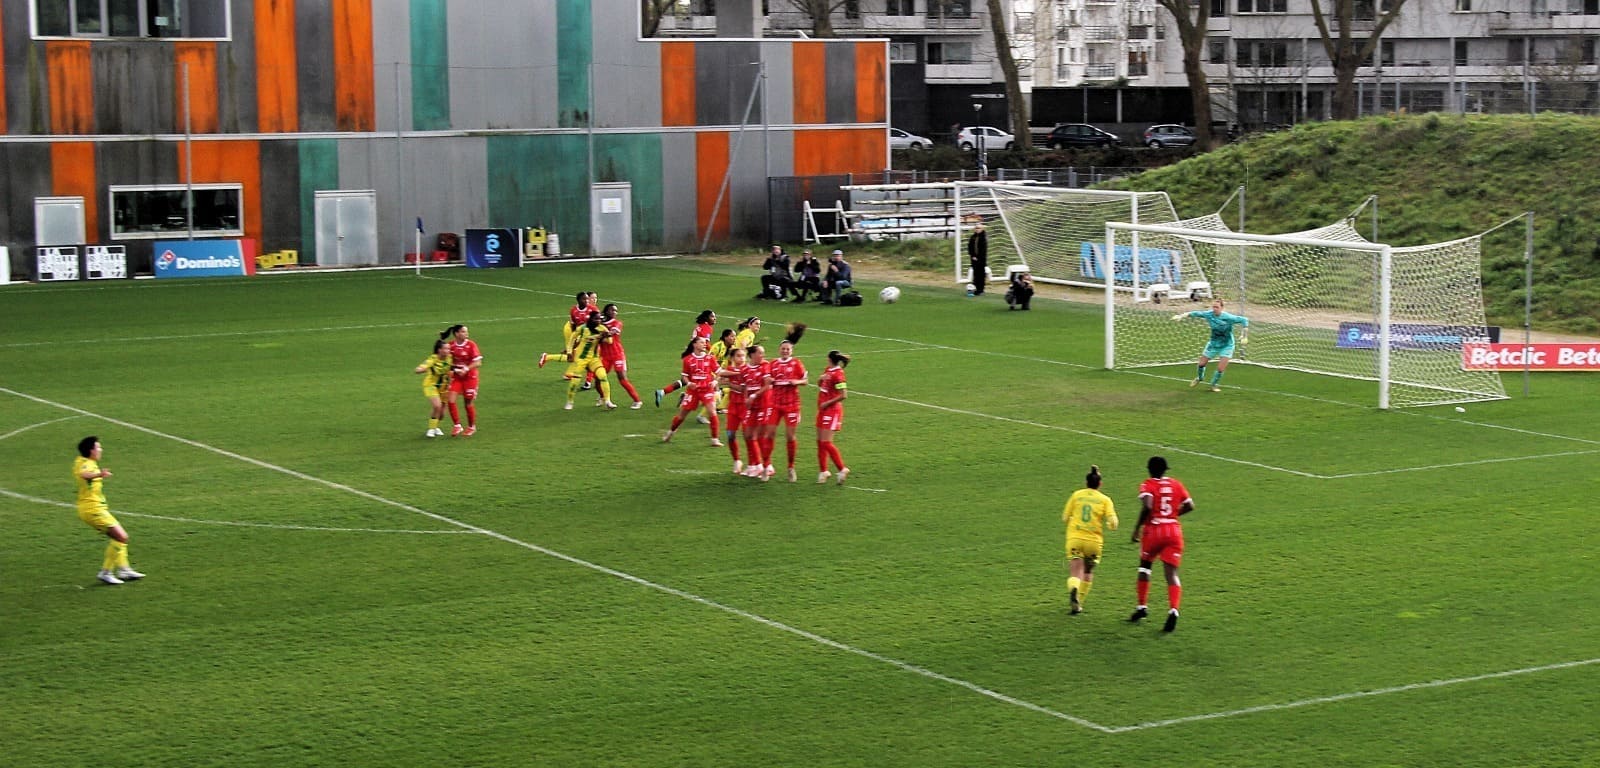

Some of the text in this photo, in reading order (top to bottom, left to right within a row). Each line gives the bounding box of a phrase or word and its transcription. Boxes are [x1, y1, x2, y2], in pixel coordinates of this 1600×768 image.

[175, 255, 241, 269] Domino's
[1470, 347, 1546, 365] Betclic
[1082, 504, 1093, 522] 8
[1160, 496, 1173, 516] 5
